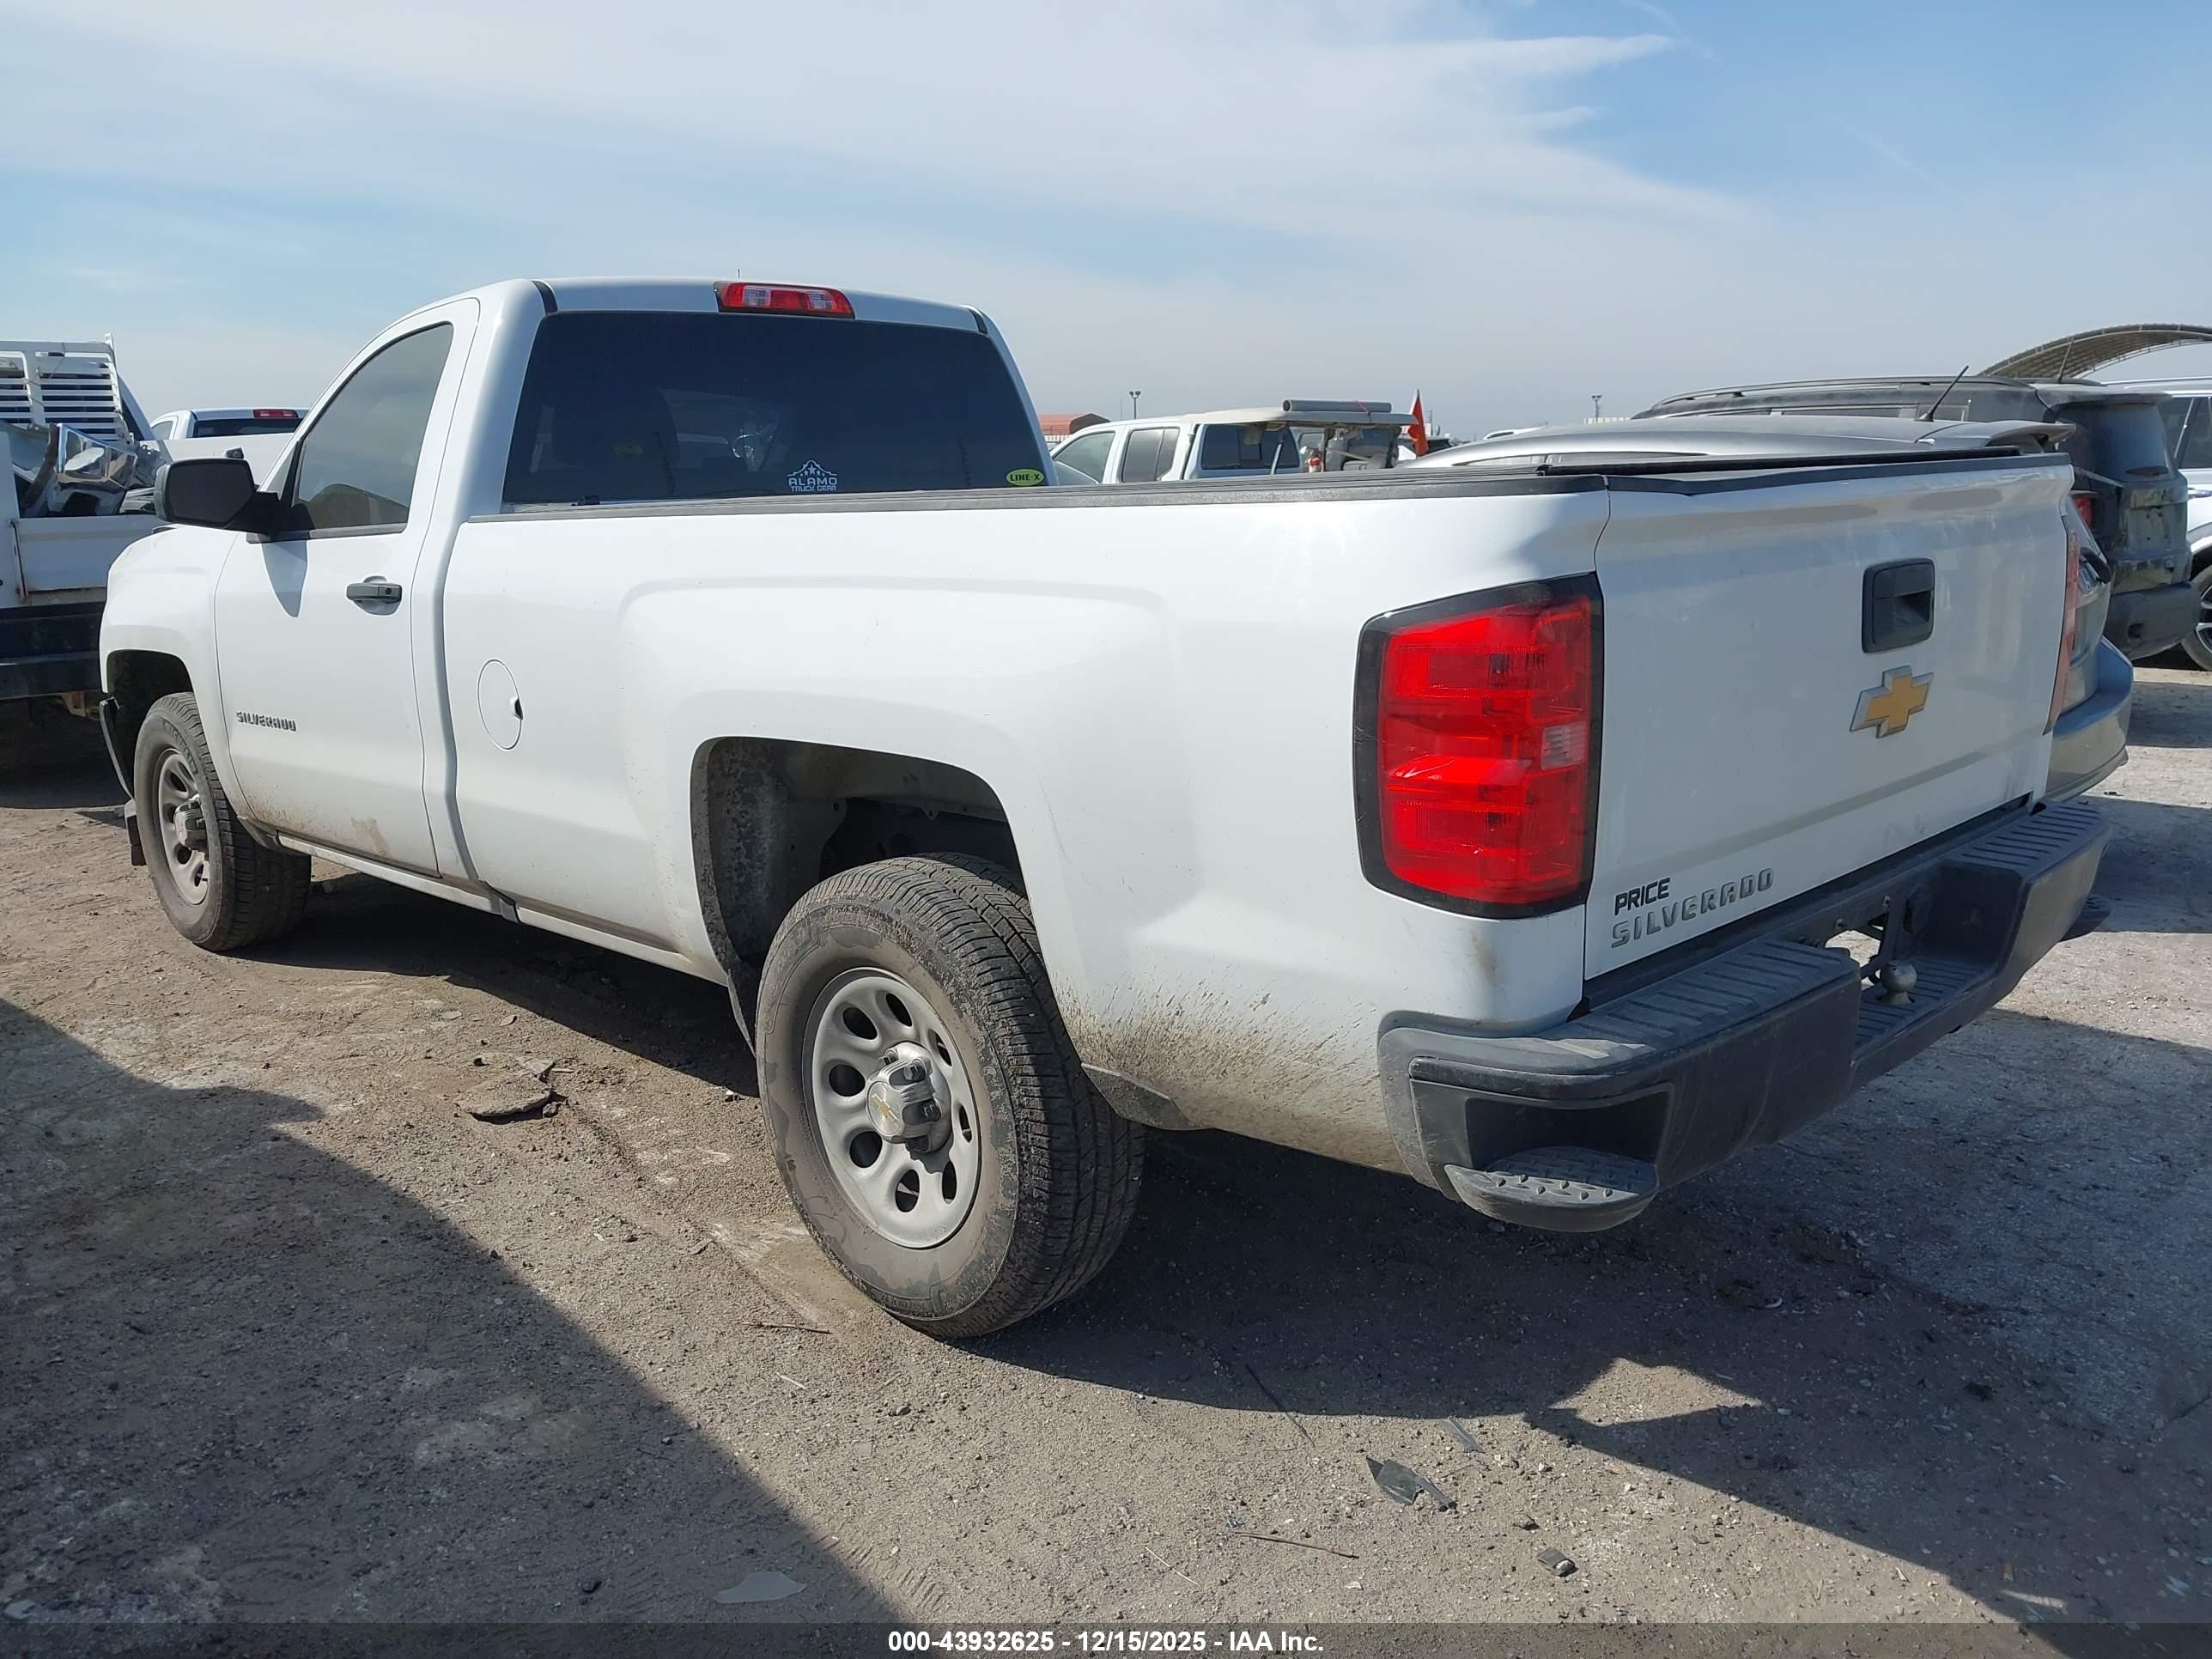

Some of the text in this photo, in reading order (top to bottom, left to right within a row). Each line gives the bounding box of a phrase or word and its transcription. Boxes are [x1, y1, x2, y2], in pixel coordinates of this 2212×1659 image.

[788, 477, 838, 486] ALAMO
[235, 711, 297, 732] SILVERADO
[1611, 867, 1774, 948] SILVERADO
[1613, 877, 1671, 916] PRICE
